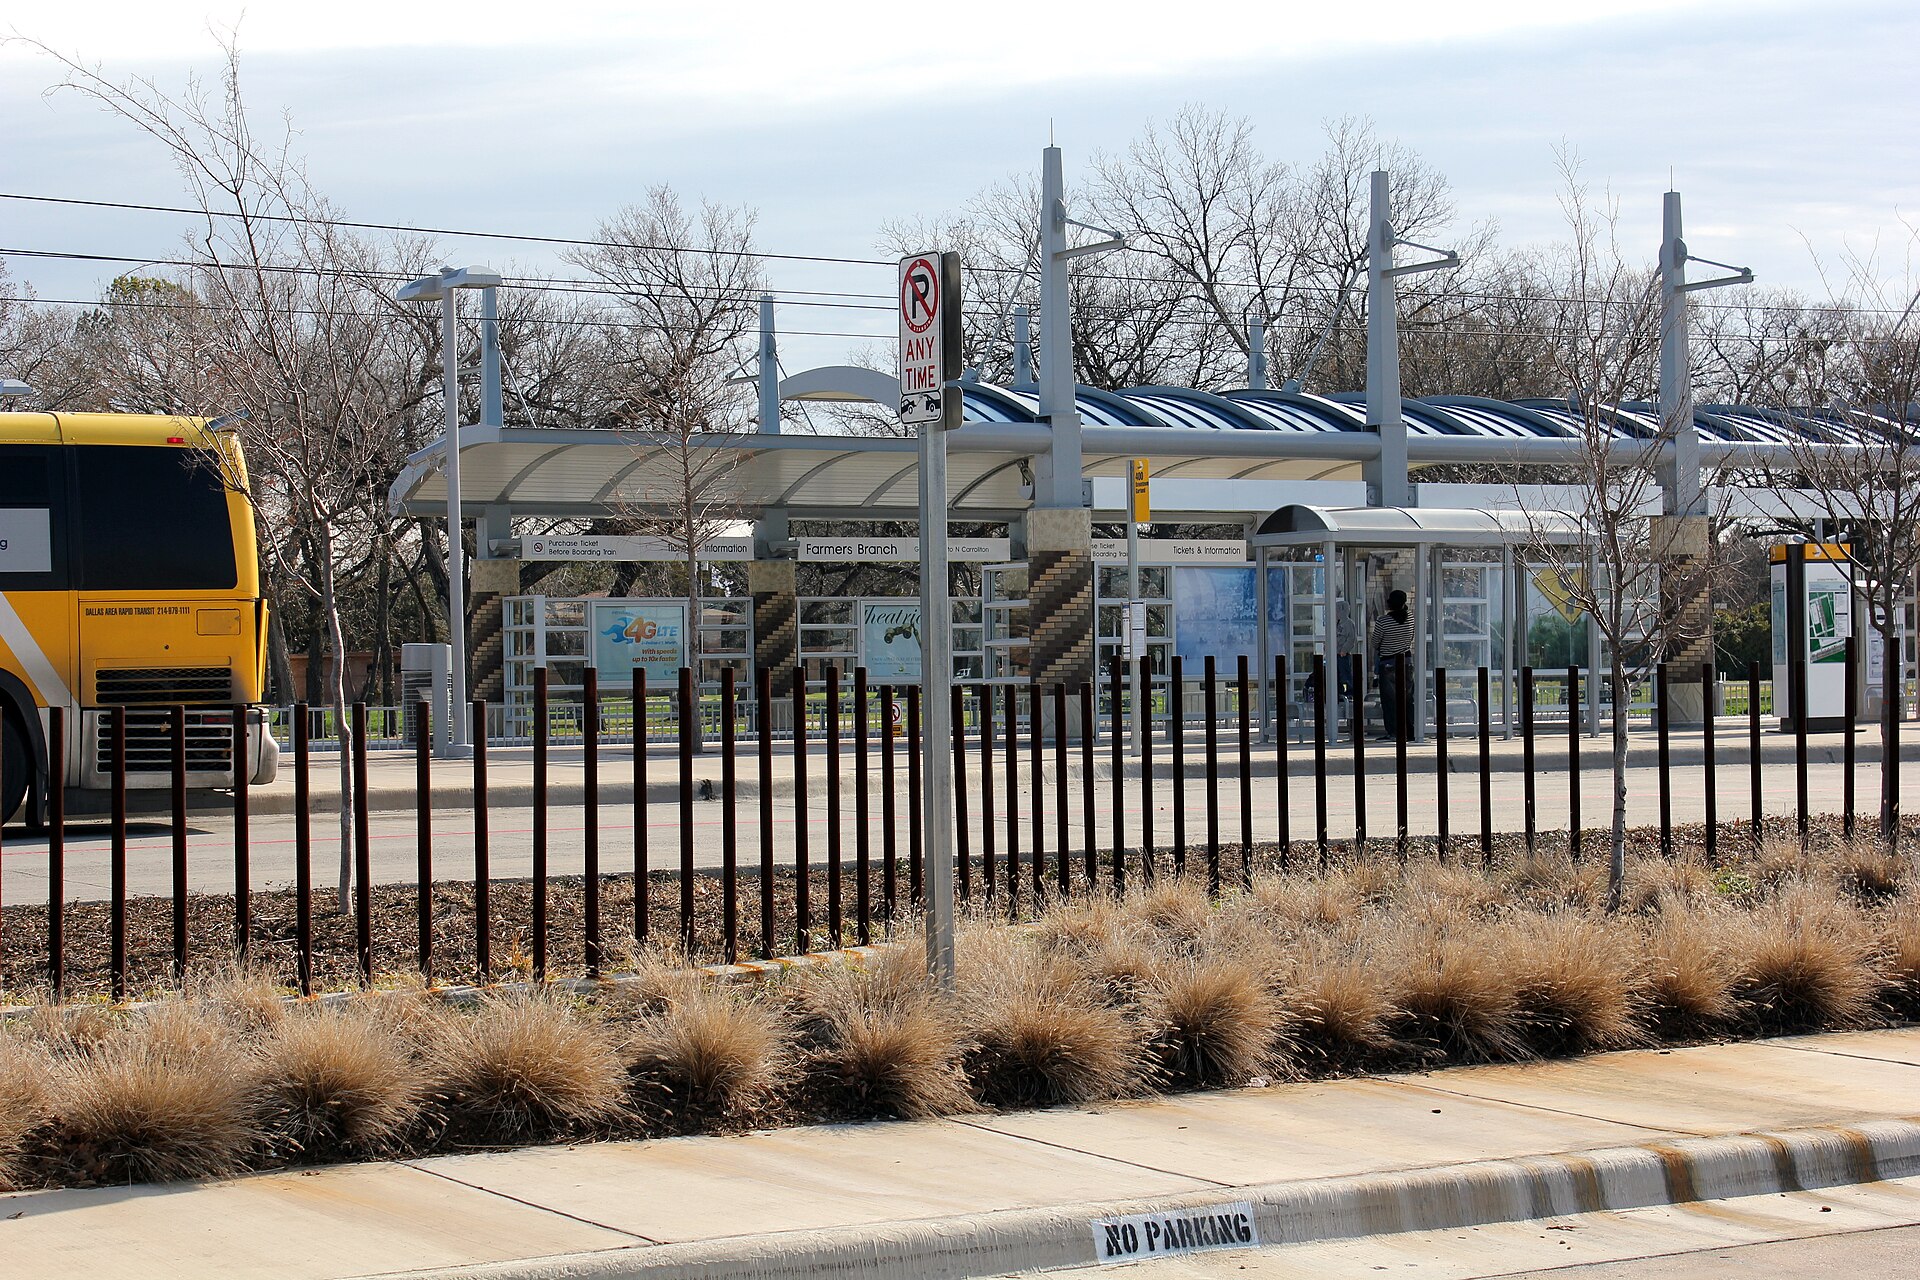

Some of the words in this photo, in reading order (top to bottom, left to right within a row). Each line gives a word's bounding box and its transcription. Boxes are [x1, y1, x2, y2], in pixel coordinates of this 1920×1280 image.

[905, 336, 936, 362] ANY
[905, 364, 936, 391] TIME
[548, 548, 570, 556] Before
[571, 548, 602, 557] Boarding
[603, 548, 617, 556] Train
[704, 543, 748, 553] Information
[806, 543, 853, 555] Farmers
[857, 543, 898, 555] Branch
[1173, 546, 1195, 555] Tickets
[1197, 547, 1203, 555] &
[1204, 546, 1241, 555] Information
[1092, 550, 1117, 558] Boarding
[85, 608, 104, 616] DALLAS
[105, 608, 117, 616] AREA
[119, 608, 134, 616] RAPID
[134, 607, 155, 615] TRANSIT
[157, 607, 190, 615] 214-979-1111
[624, 616, 657, 644] 4G
[657, 626, 678, 637] LTE
[656, 648, 677, 656] speeds
[1104, 1223, 1139, 1257] NO
[1144, 1213, 1251, 1252] PARKING
